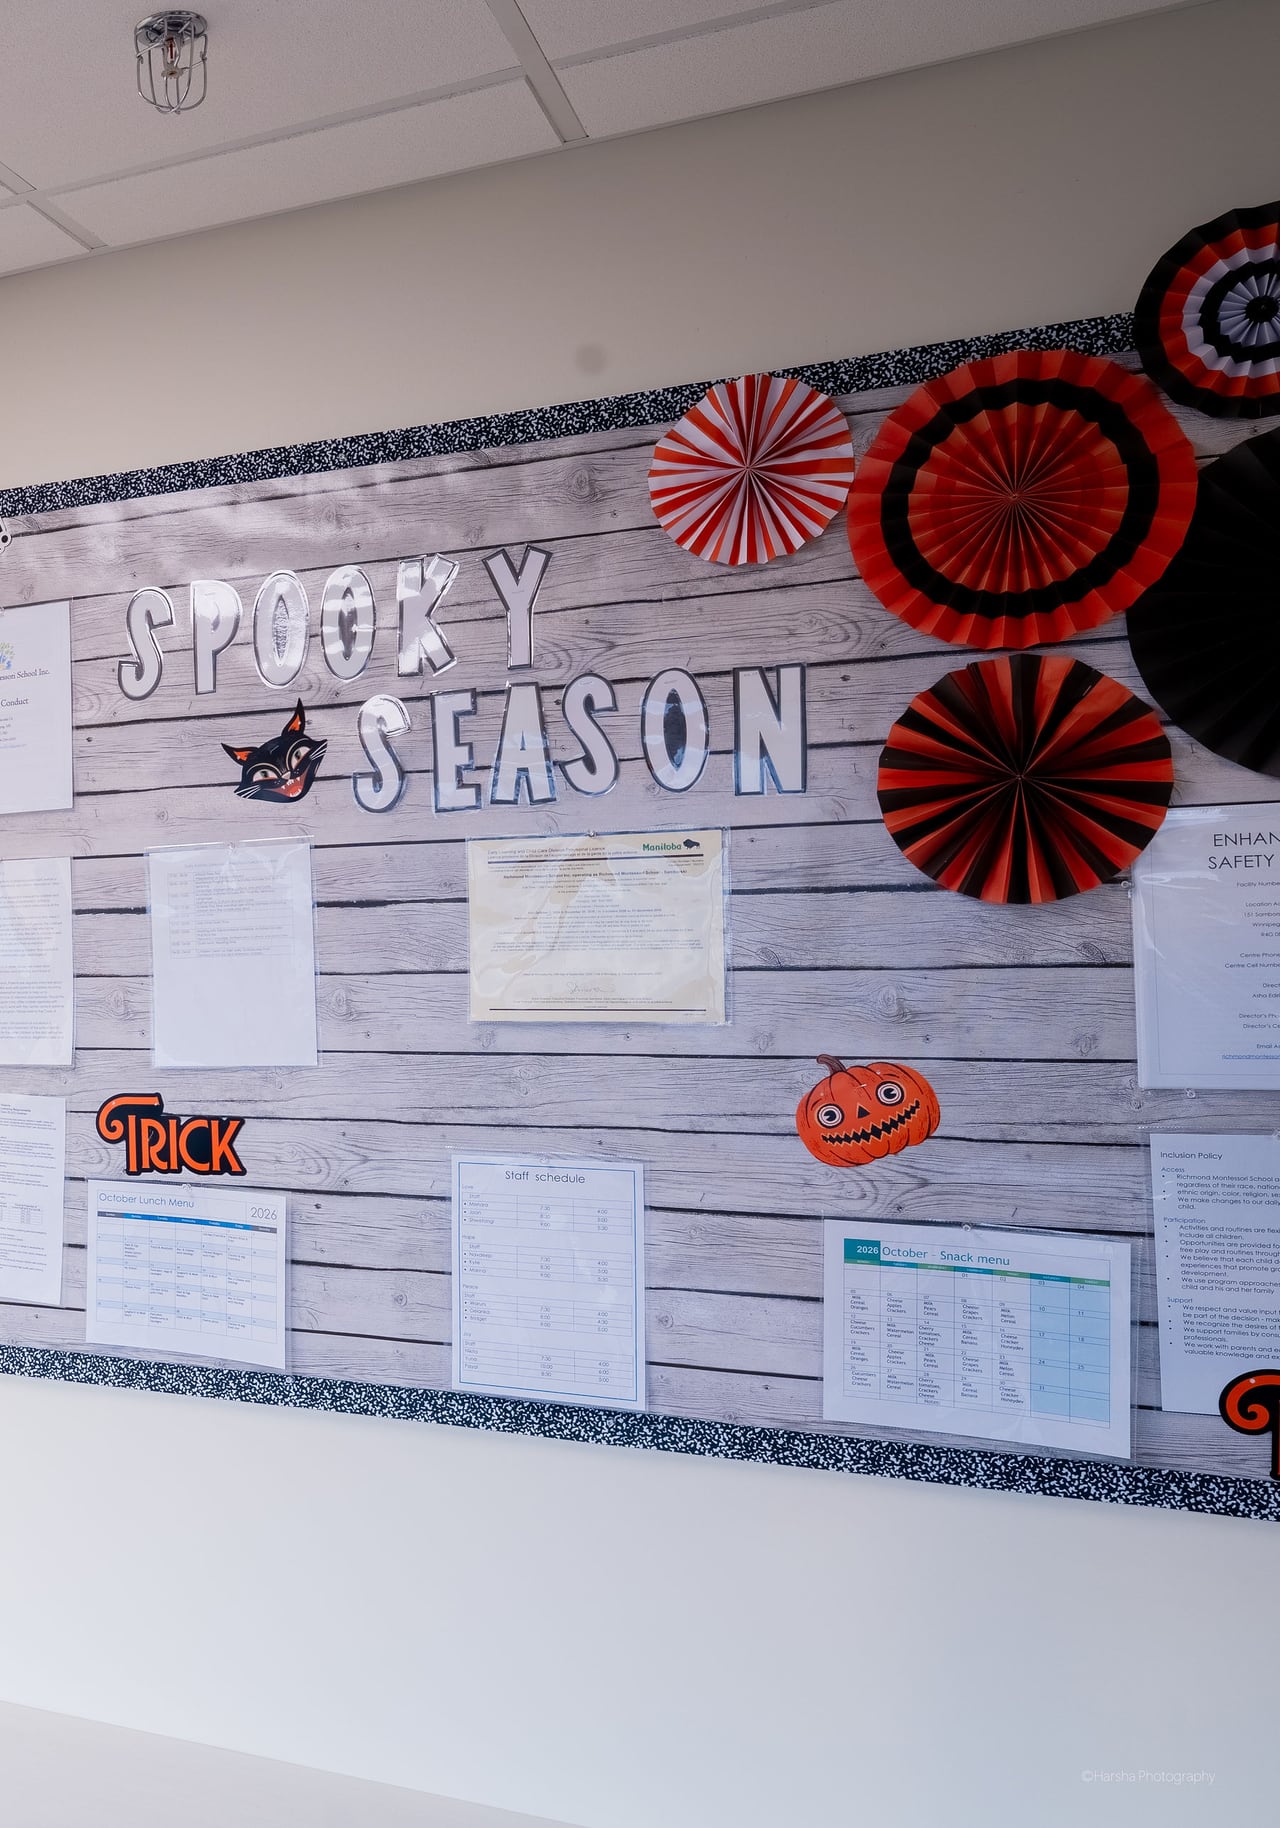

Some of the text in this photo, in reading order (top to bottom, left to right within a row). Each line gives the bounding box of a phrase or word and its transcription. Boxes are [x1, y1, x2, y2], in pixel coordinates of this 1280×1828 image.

[118, 543, 553, 700] SPOOKY
[16, 669, 38, 680] School
[38, 667, 50, 676] Inc.
[0, 697, 29, 708] Conduct
[352, 662, 807, 813] SEASON
[1213, 832, 1280, 847] ENHAN
[642, 843, 681, 851] Manitoba
[1208, 854, 1274, 870] SAFETY
[98, 1096, 244, 1173] TRICK
[1198, 1152, 1223, 1160] Policy
[505, 1170, 586, 1184] Staff schedule
[99, 1193, 195, 1208] October Lunch Menu
[250, 1207, 277, 1220] 2026
[856, 1245, 1010, 1265] 2026 October Snack menu
[1216, 1350, 1254, 1359] knowledge
